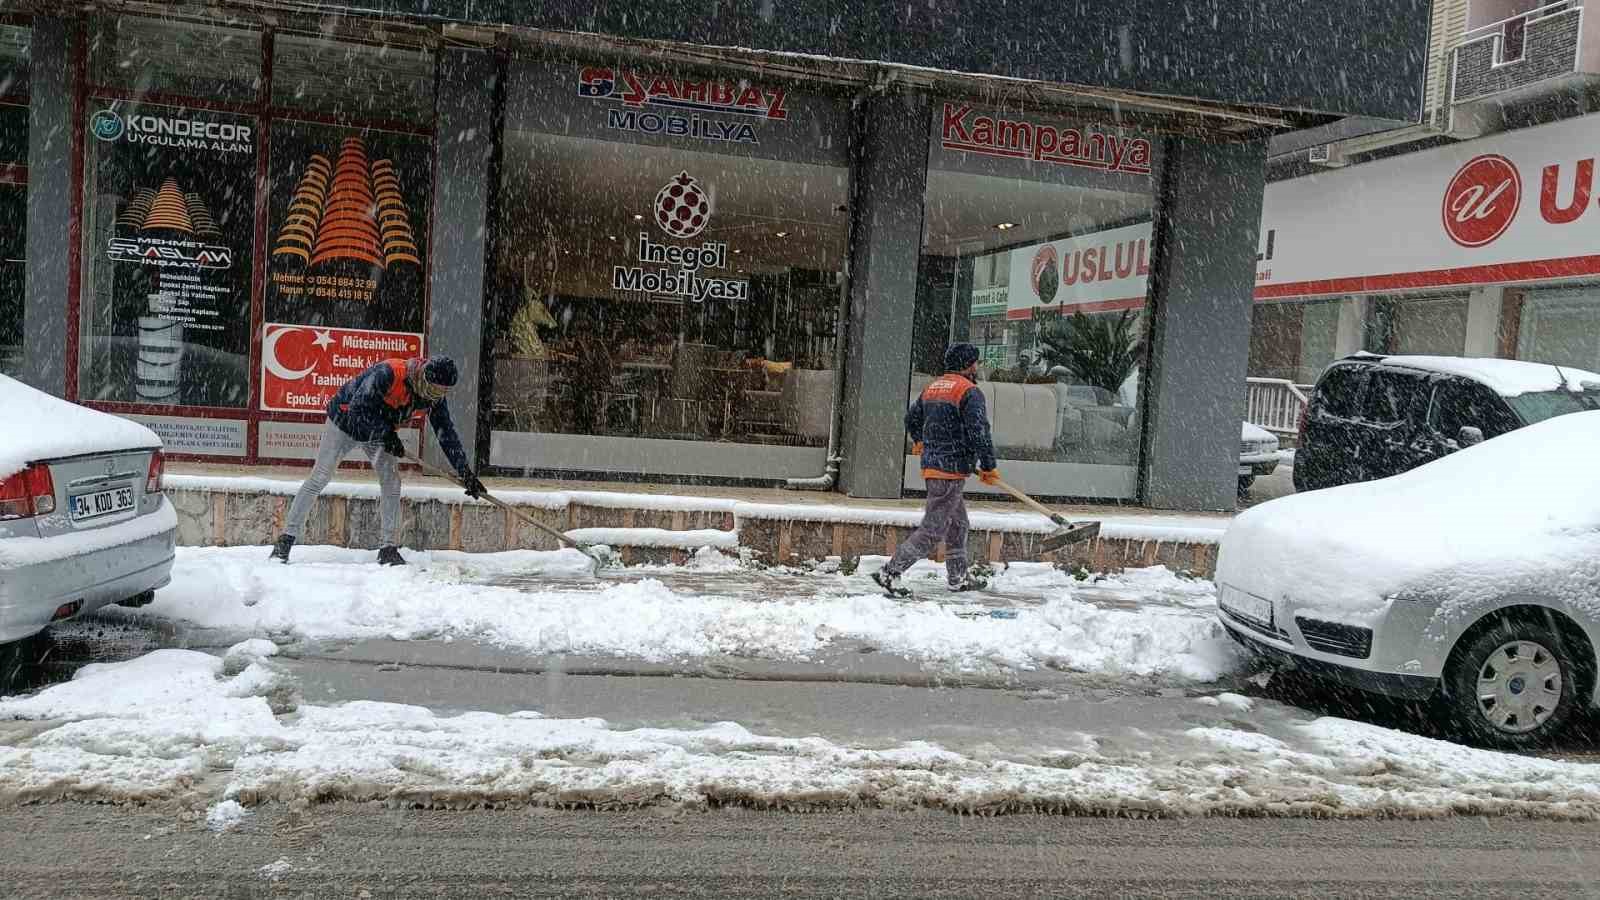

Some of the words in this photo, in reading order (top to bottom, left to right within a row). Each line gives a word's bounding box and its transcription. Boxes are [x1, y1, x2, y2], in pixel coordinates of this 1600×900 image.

[127, 115, 252, 142] KONDECOR
[608, 109, 760, 144] MOBİLYA
[943, 103, 1151, 171] Kampanya
[127, 133, 208, 150] UYGULAMA
[211, 142, 253, 154] ALANI
[1540, 158, 1600, 224] U
[137, 237, 206, 249] MEHMET
[639, 232, 727, 271] İnegöl
[613, 266, 750, 302] Mobilyası
[342, 335, 408, 352] Müteahhitlik
[332, 355, 364, 369] Emlak
[286, 391, 321, 408] Epoksi
[77, 496, 90, 517] 34
[116, 488, 133, 508] 363
